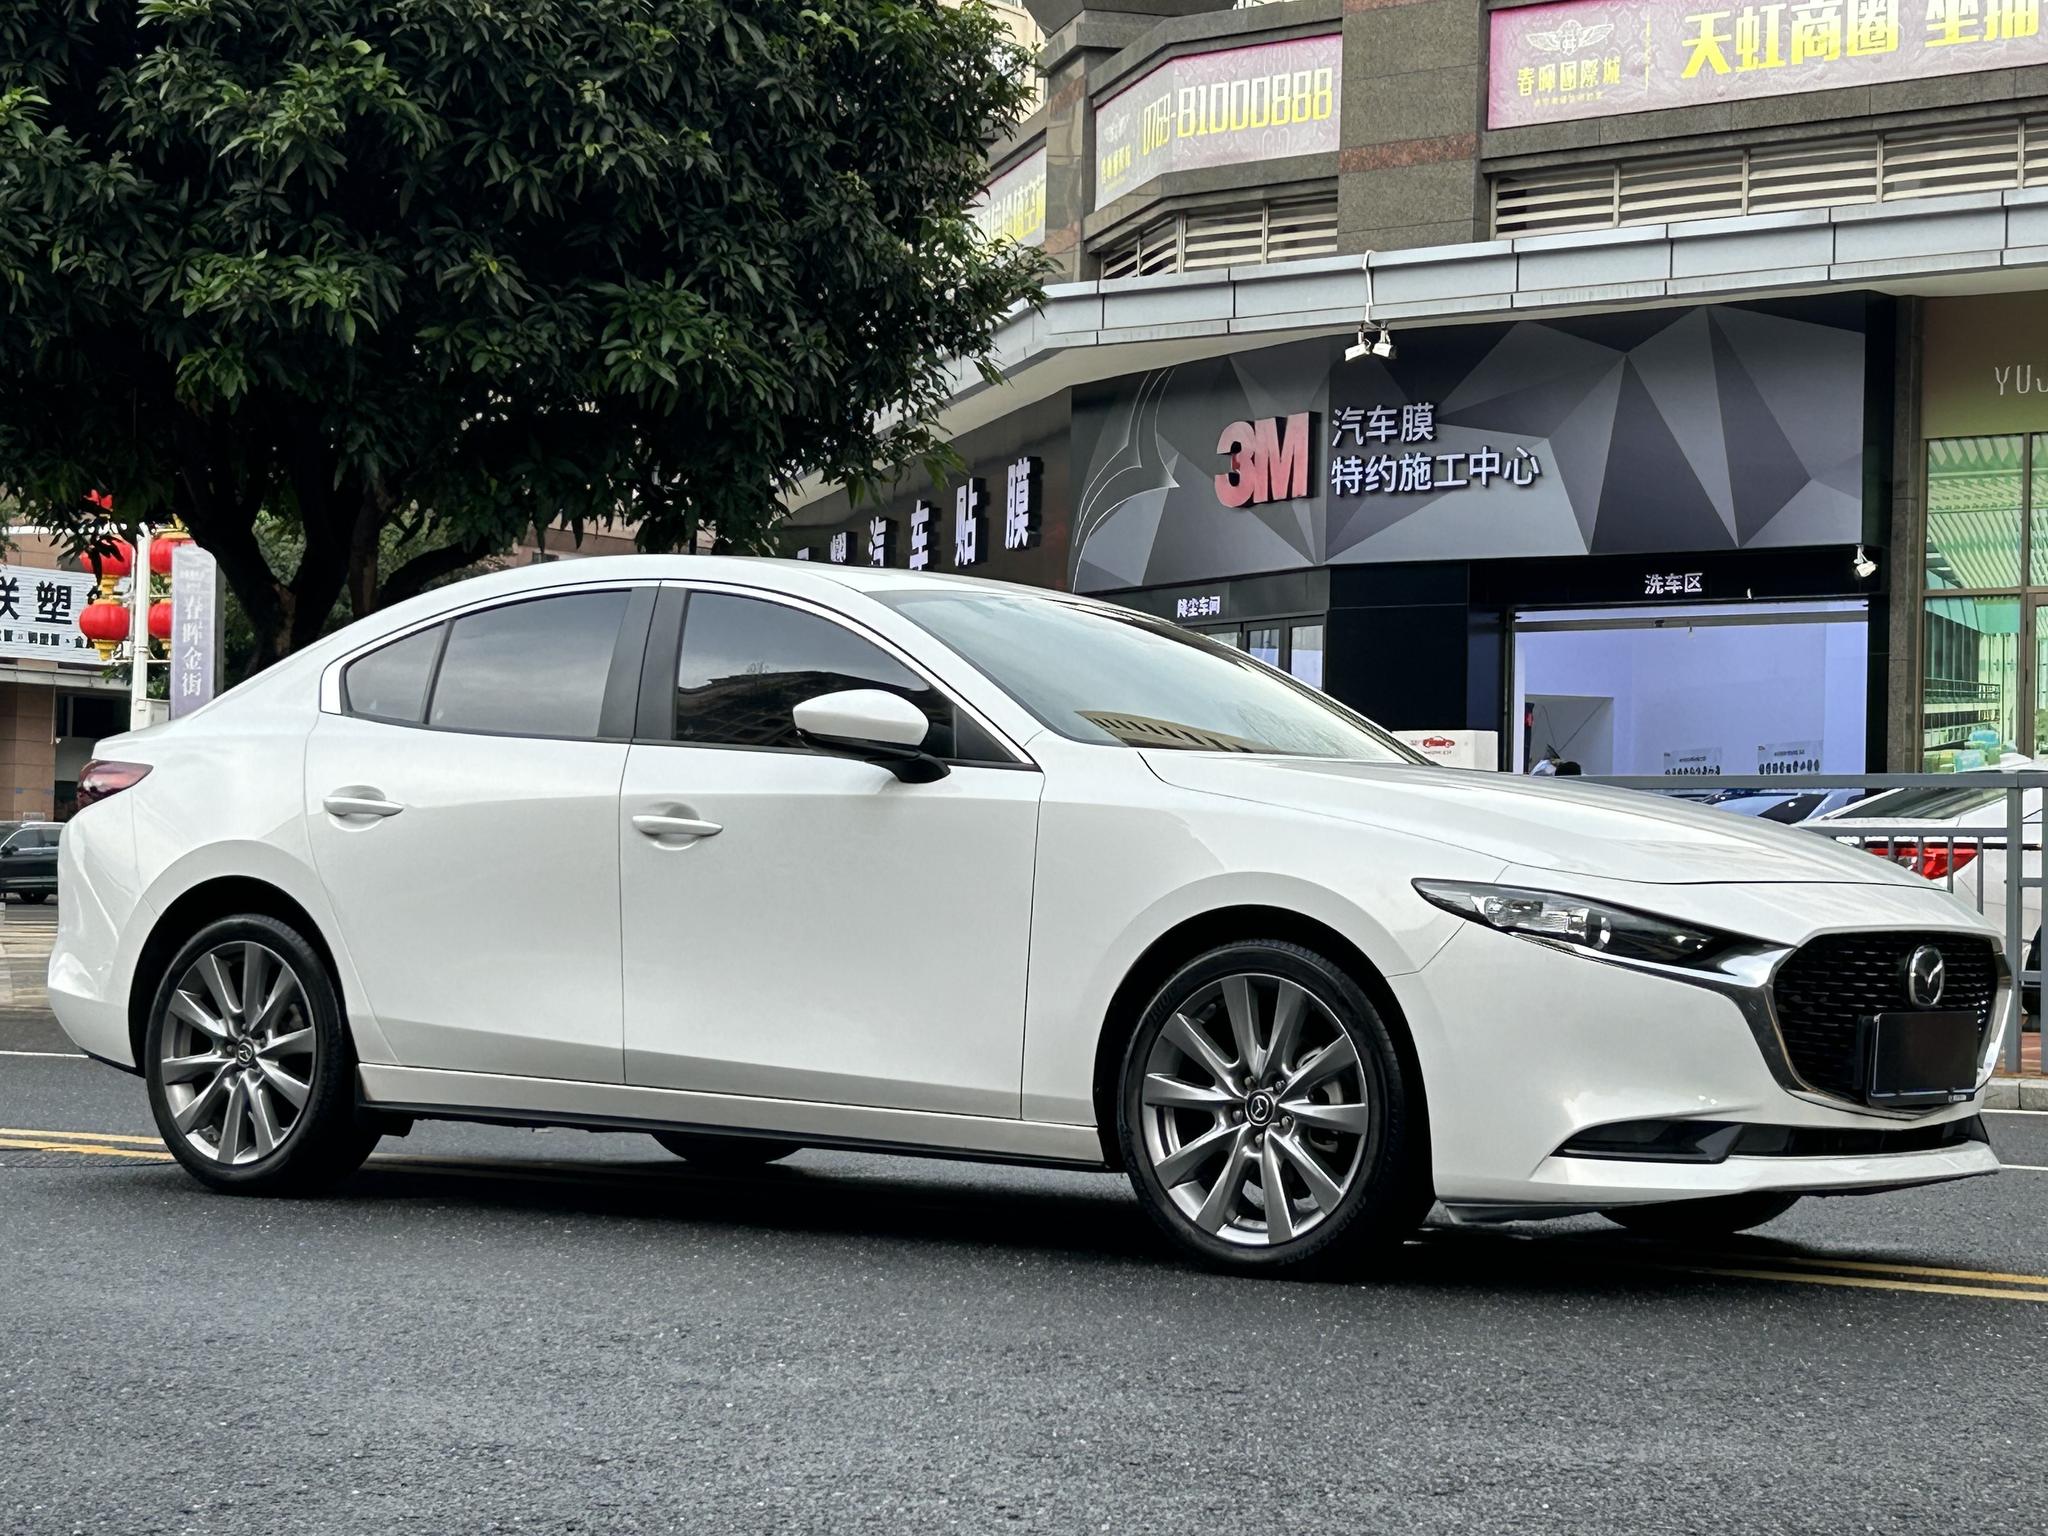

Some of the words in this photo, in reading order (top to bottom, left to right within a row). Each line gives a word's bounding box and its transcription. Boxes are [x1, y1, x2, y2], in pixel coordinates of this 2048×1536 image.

[1681, 0, 1899, 79] 天虹商圈
[1925, 0, 2048, 48] 坐拥
[1331, 402, 1435, 447] 汽车膜
[1214, 411, 1310, 508] 3M
[1331, 446, 1542, 496] 特约施工中心
[1177, 595, 1221, 618] 降尘车间
[1644, 573, 1703, 595] 洗车区
